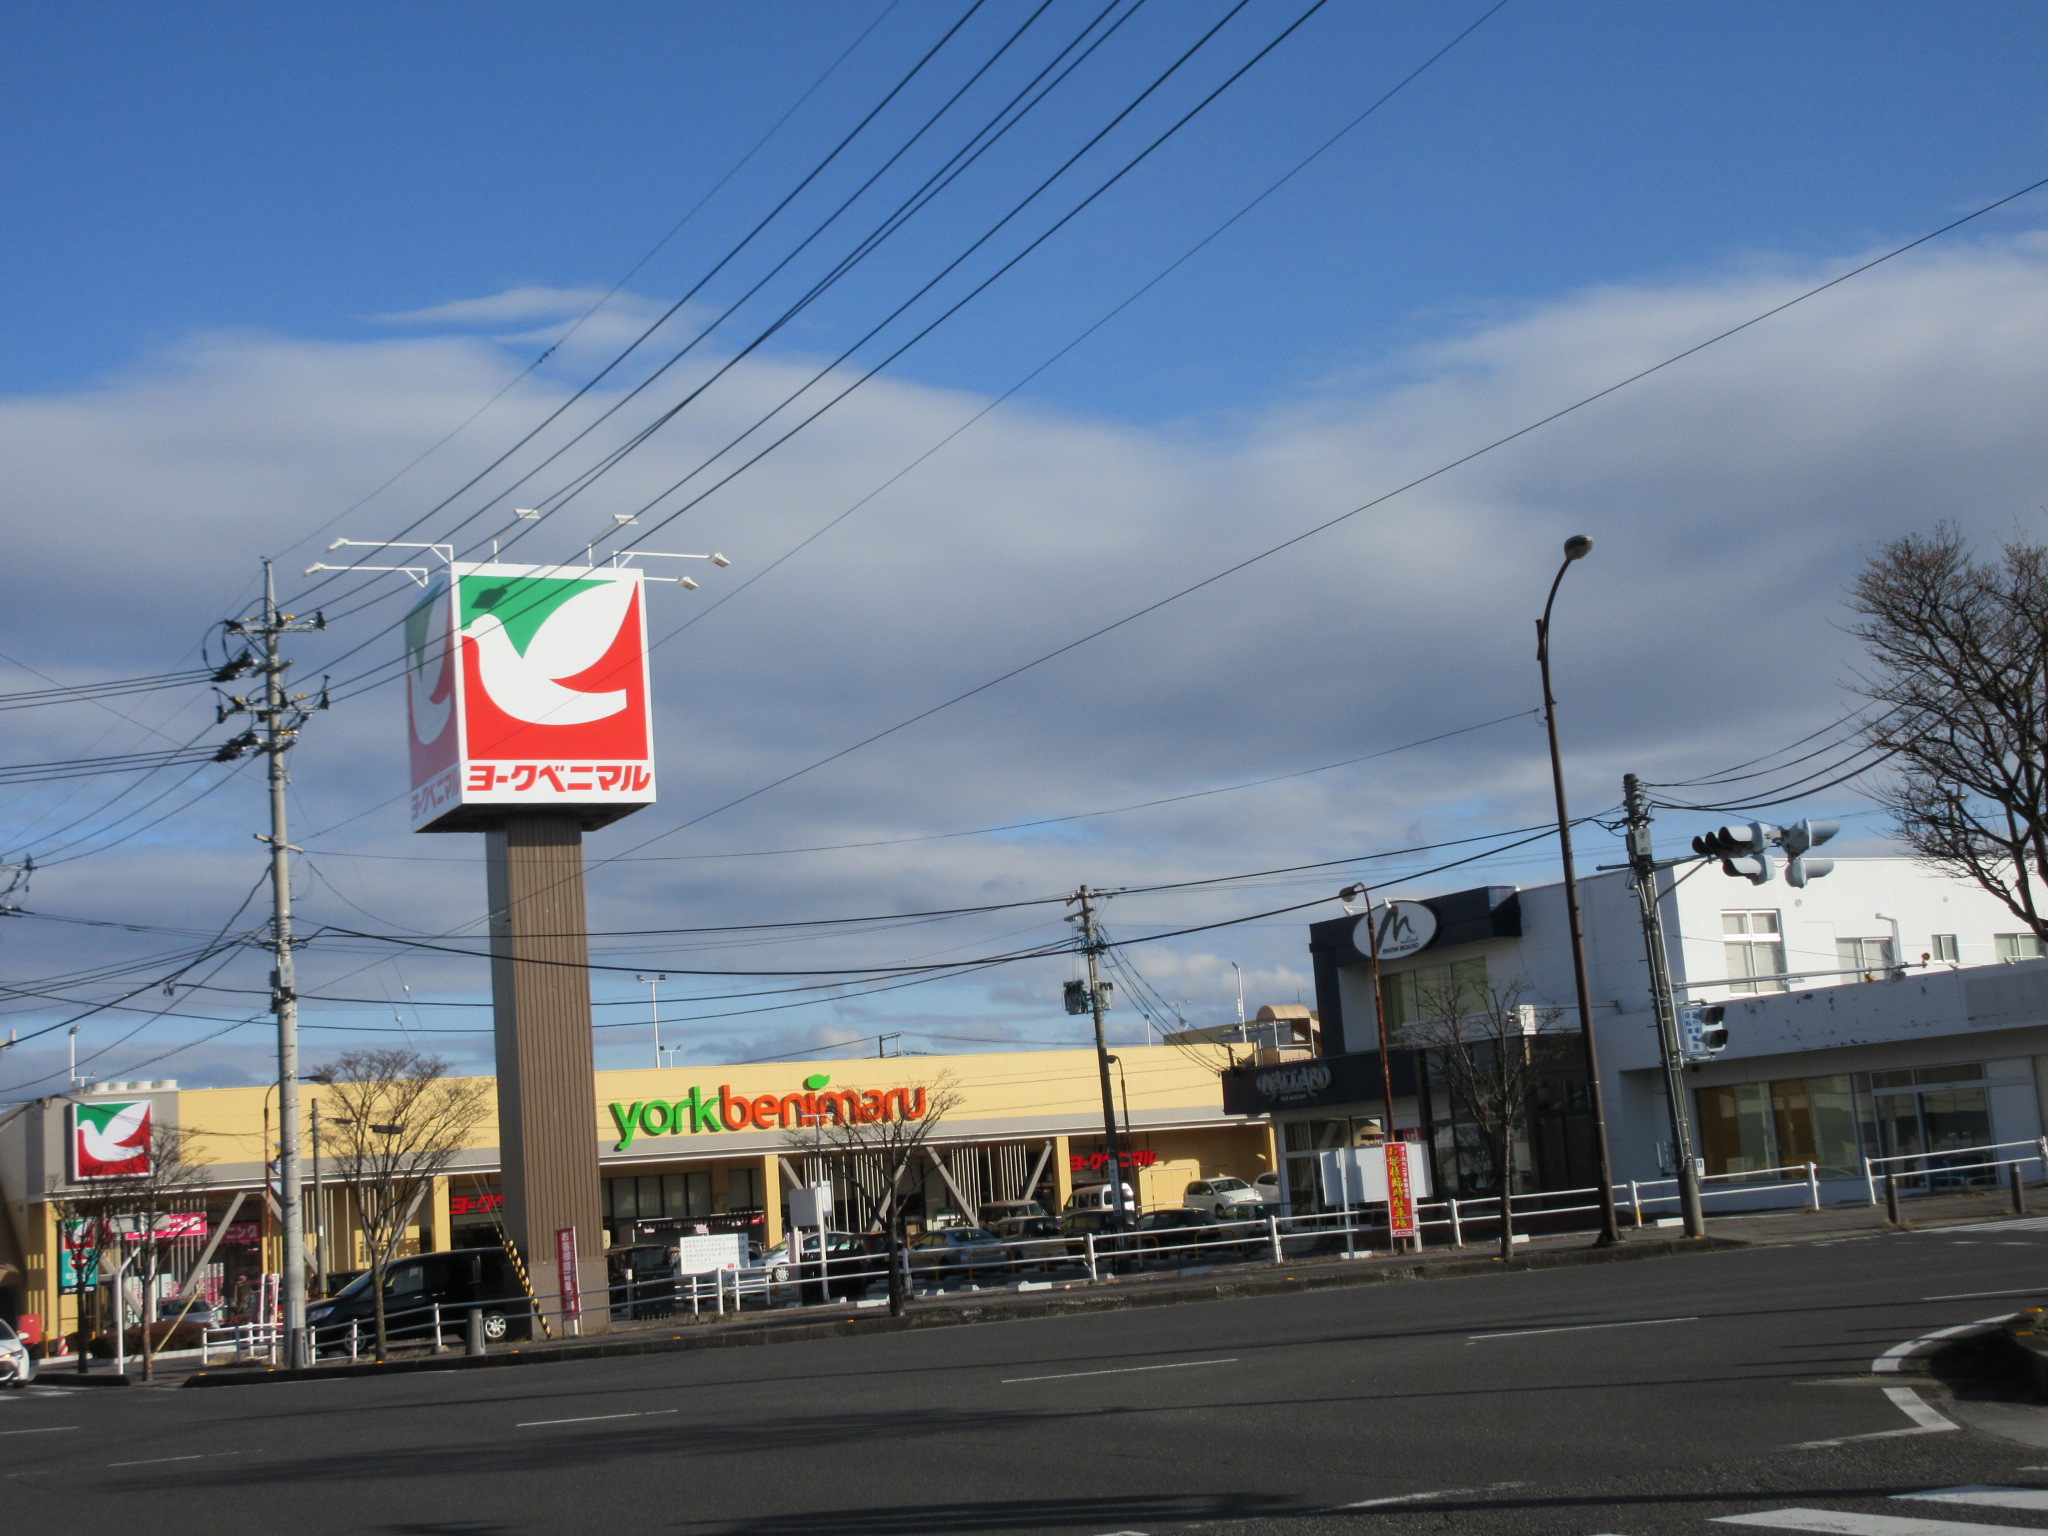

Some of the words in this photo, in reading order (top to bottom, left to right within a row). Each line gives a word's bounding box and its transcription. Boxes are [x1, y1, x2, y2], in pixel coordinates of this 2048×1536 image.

[466, 765, 652, 793] ヨークベニマル
[1388, 1146, 1407, 1229] お客様臨時駐車場
